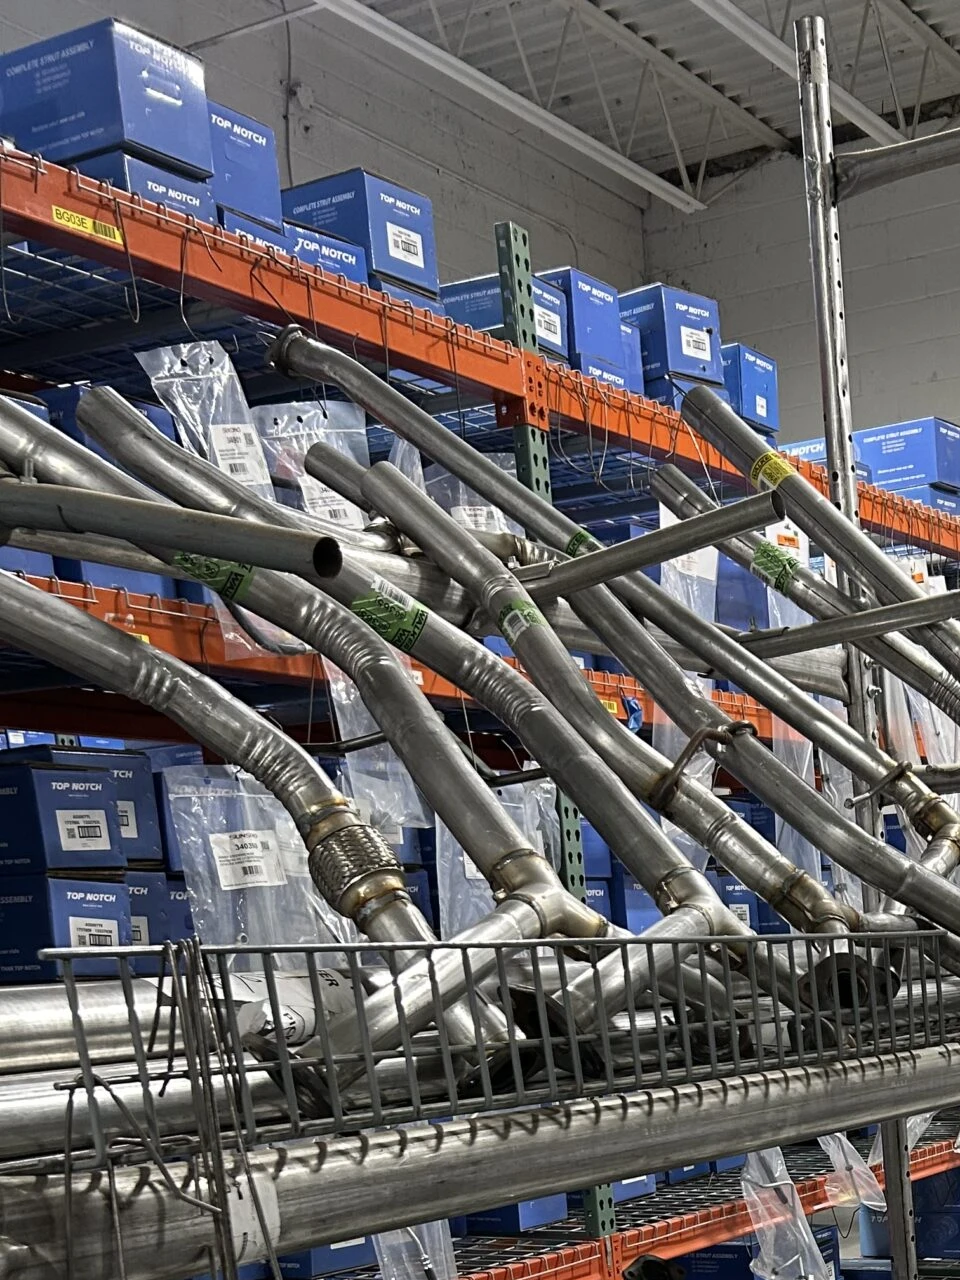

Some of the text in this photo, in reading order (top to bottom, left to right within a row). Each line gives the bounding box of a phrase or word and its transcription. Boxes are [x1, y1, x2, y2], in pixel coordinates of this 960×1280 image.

[39, 50, 62, 68] STRUT
[211, 114, 232, 129] TOP
[233, 125, 267, 147] NOTCH
[147, 181, 200, 207] TOP NOTCH
[292, 191, 356, 214] COMPLETE STRUT ASSEMBLY
[380, 193, 421, 216] TOP NOTCH
[54, 208, 88, 229] BG03E
[297, 238, 357, 266] TOP NOTCH
[543, 292, 561, 305] NOTCH
[577, 281, 591, 293] TOP
[592, 288, 614, 303] NOTCH
[675, 303, 710, 317] TOP NOTCH
[745, 353, 756, 363] TOP
[756, 358, 773, 372] NOTCH
[588, 366, 625, 386] TOP NOTCH
[112, 769, 133, 779] TCH
[51, 782, 103, 791] TOP NOTCH
[66, 891, 117, 903] TOP NOTCH
[128, 886, 149, 895] TCH
[169, 890, 191, 900] TOP
